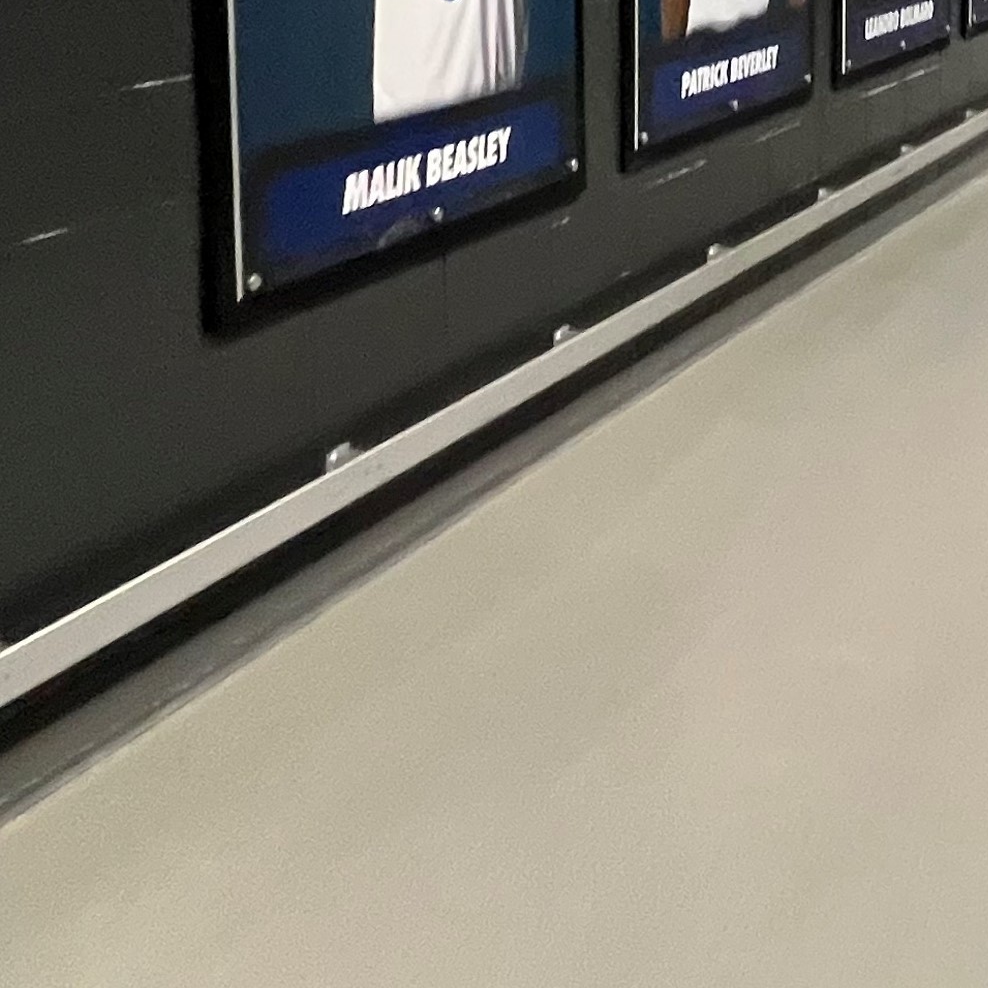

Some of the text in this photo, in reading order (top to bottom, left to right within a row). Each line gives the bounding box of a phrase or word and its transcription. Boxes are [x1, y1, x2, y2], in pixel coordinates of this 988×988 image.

[681, 44, 779, 99] PATRICK BEVERLEY
[342, 126, 511, 215] MALIK BEASLEY
